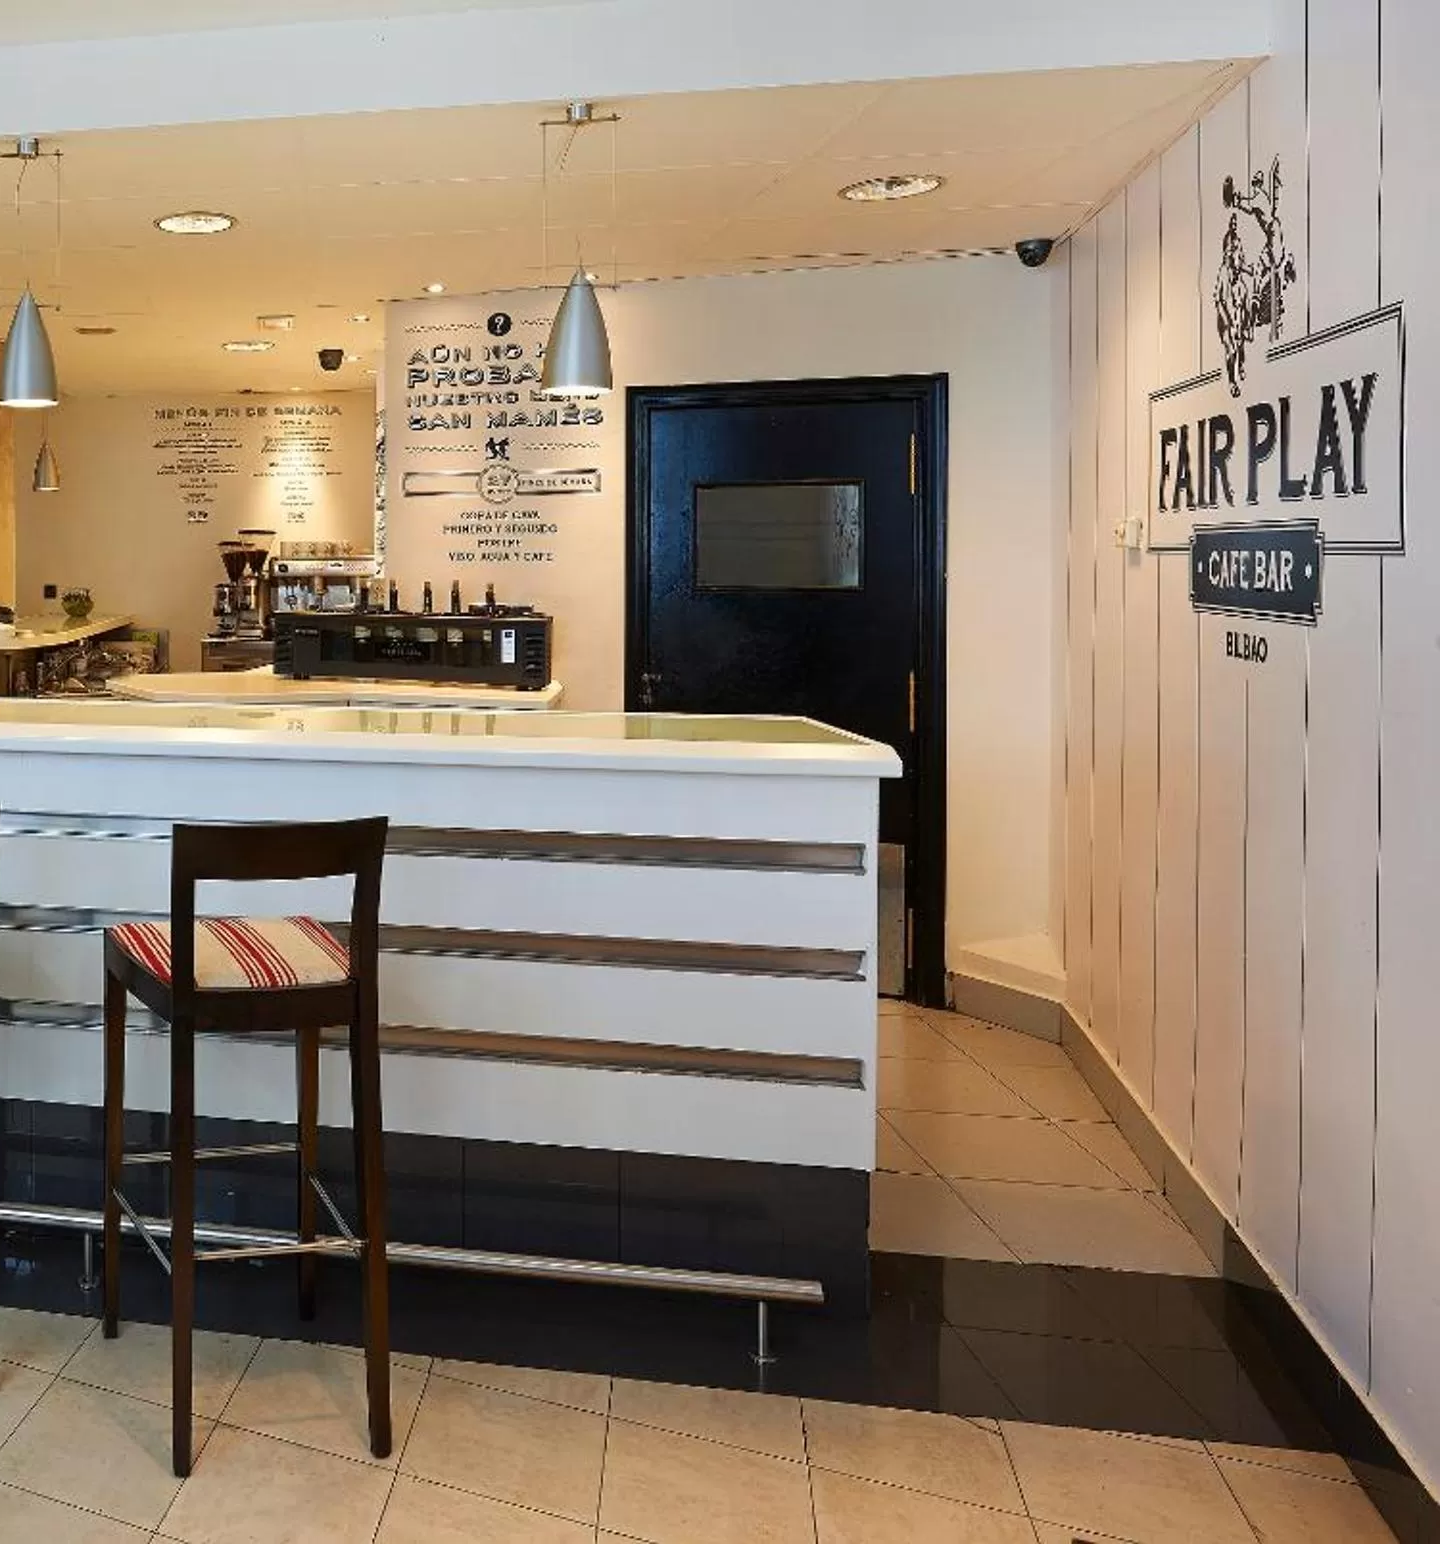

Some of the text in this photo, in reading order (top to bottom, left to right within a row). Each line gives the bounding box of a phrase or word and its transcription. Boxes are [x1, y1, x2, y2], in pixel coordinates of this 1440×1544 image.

[484, 343, 523, 360] NO
[407, 363, 543, 388] PROBA
[407, 390, 519, 407] NUESTRO
[408, 413, 471, 431] SAN
[1158, 372, 1380, 513] FAIR PLAY
[1208, 550, 1294, 593] CAFE BAR
[1226, 631, 1269, 663] BILBAO
